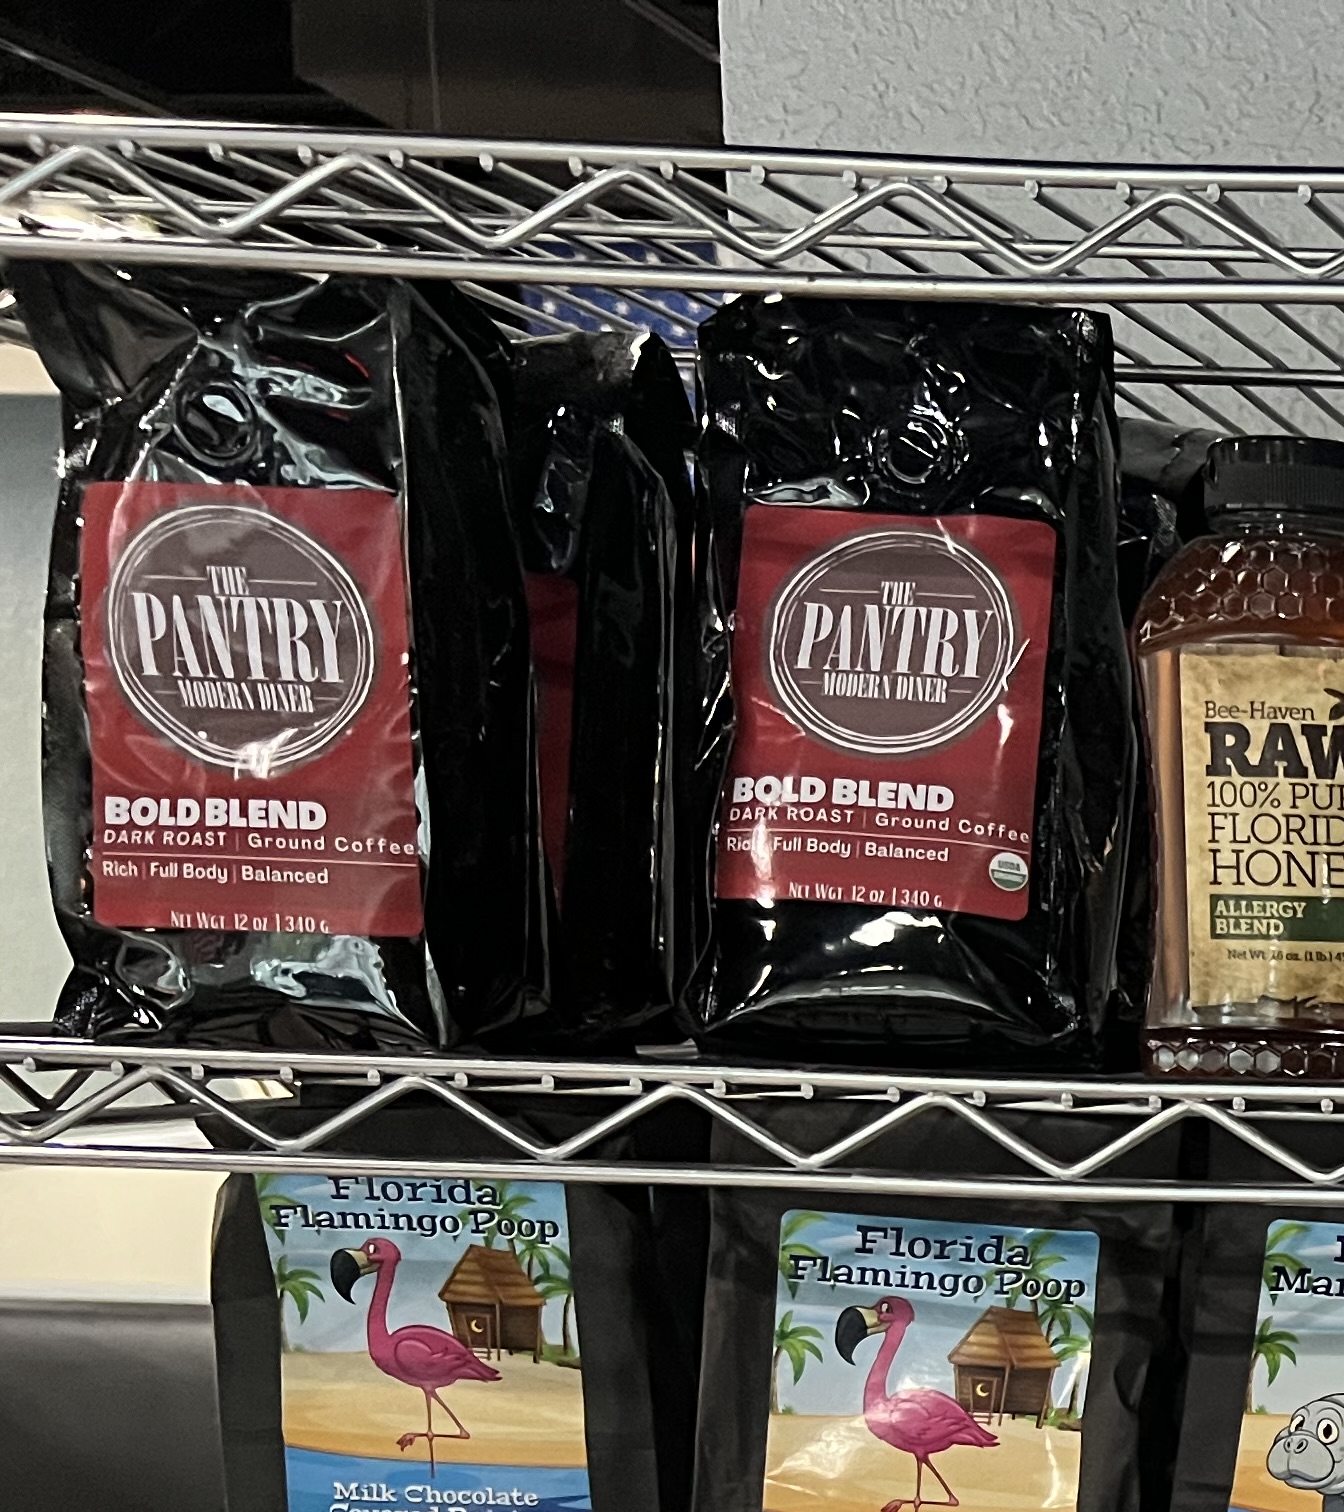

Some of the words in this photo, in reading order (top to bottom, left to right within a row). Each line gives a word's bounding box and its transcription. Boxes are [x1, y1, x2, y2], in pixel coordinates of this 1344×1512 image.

[206, 565, 249, 596] THE
[880, 581, 917, 606] THE
[132, 592, 344, 684] PANTRY
[794, 602, 995, 679] PANTRY
[177, 679, 255, 711] MODERN
[259, 682, 315, 713] DINER
[1204, 700, 1315, 721] Bee-Haven
[732, 776, 827, 804] BOLD
[832, 779, 955, 812] BLEND
[1206, 781, 1281, 809] 100%
[104, 796, 201, 827] BOLD
[205, 798, 327, 830] BLEND
[729, 807, 779, 822] DARK
[786, 807, 854, 824] ROAST
[875, 812, 950, 832] Ground
[958, 819, 1030, 843] Coffee
[103, 828, 155, 847] DARK
[162, 830, 227, 848] ROAST
[247, 832, 325, 852] Ground
[335, 836, 415, 856] Coffee
[102, 861, 138, 878] Rich
[150, 862, 178, 880] Full
[183, 863, 229, 884] Body
[241, 865, 329, 884] Balanced
[234, 913, 249, 931] 12
[1214, 900, 1307, 919] ALLERGY
[1215, 918, 1285, 936] BLEND
[328, 1177, 500, 1207] Florida
[269, 1203, 461, 1238] Flamingo
[469, 1209, 560, 1245] Poop
[854, 1224, 1032, 1268] Florida
[787, 1253, 988, 1298] Flamingo
[993, 1269, 1087, 1305] Poop
